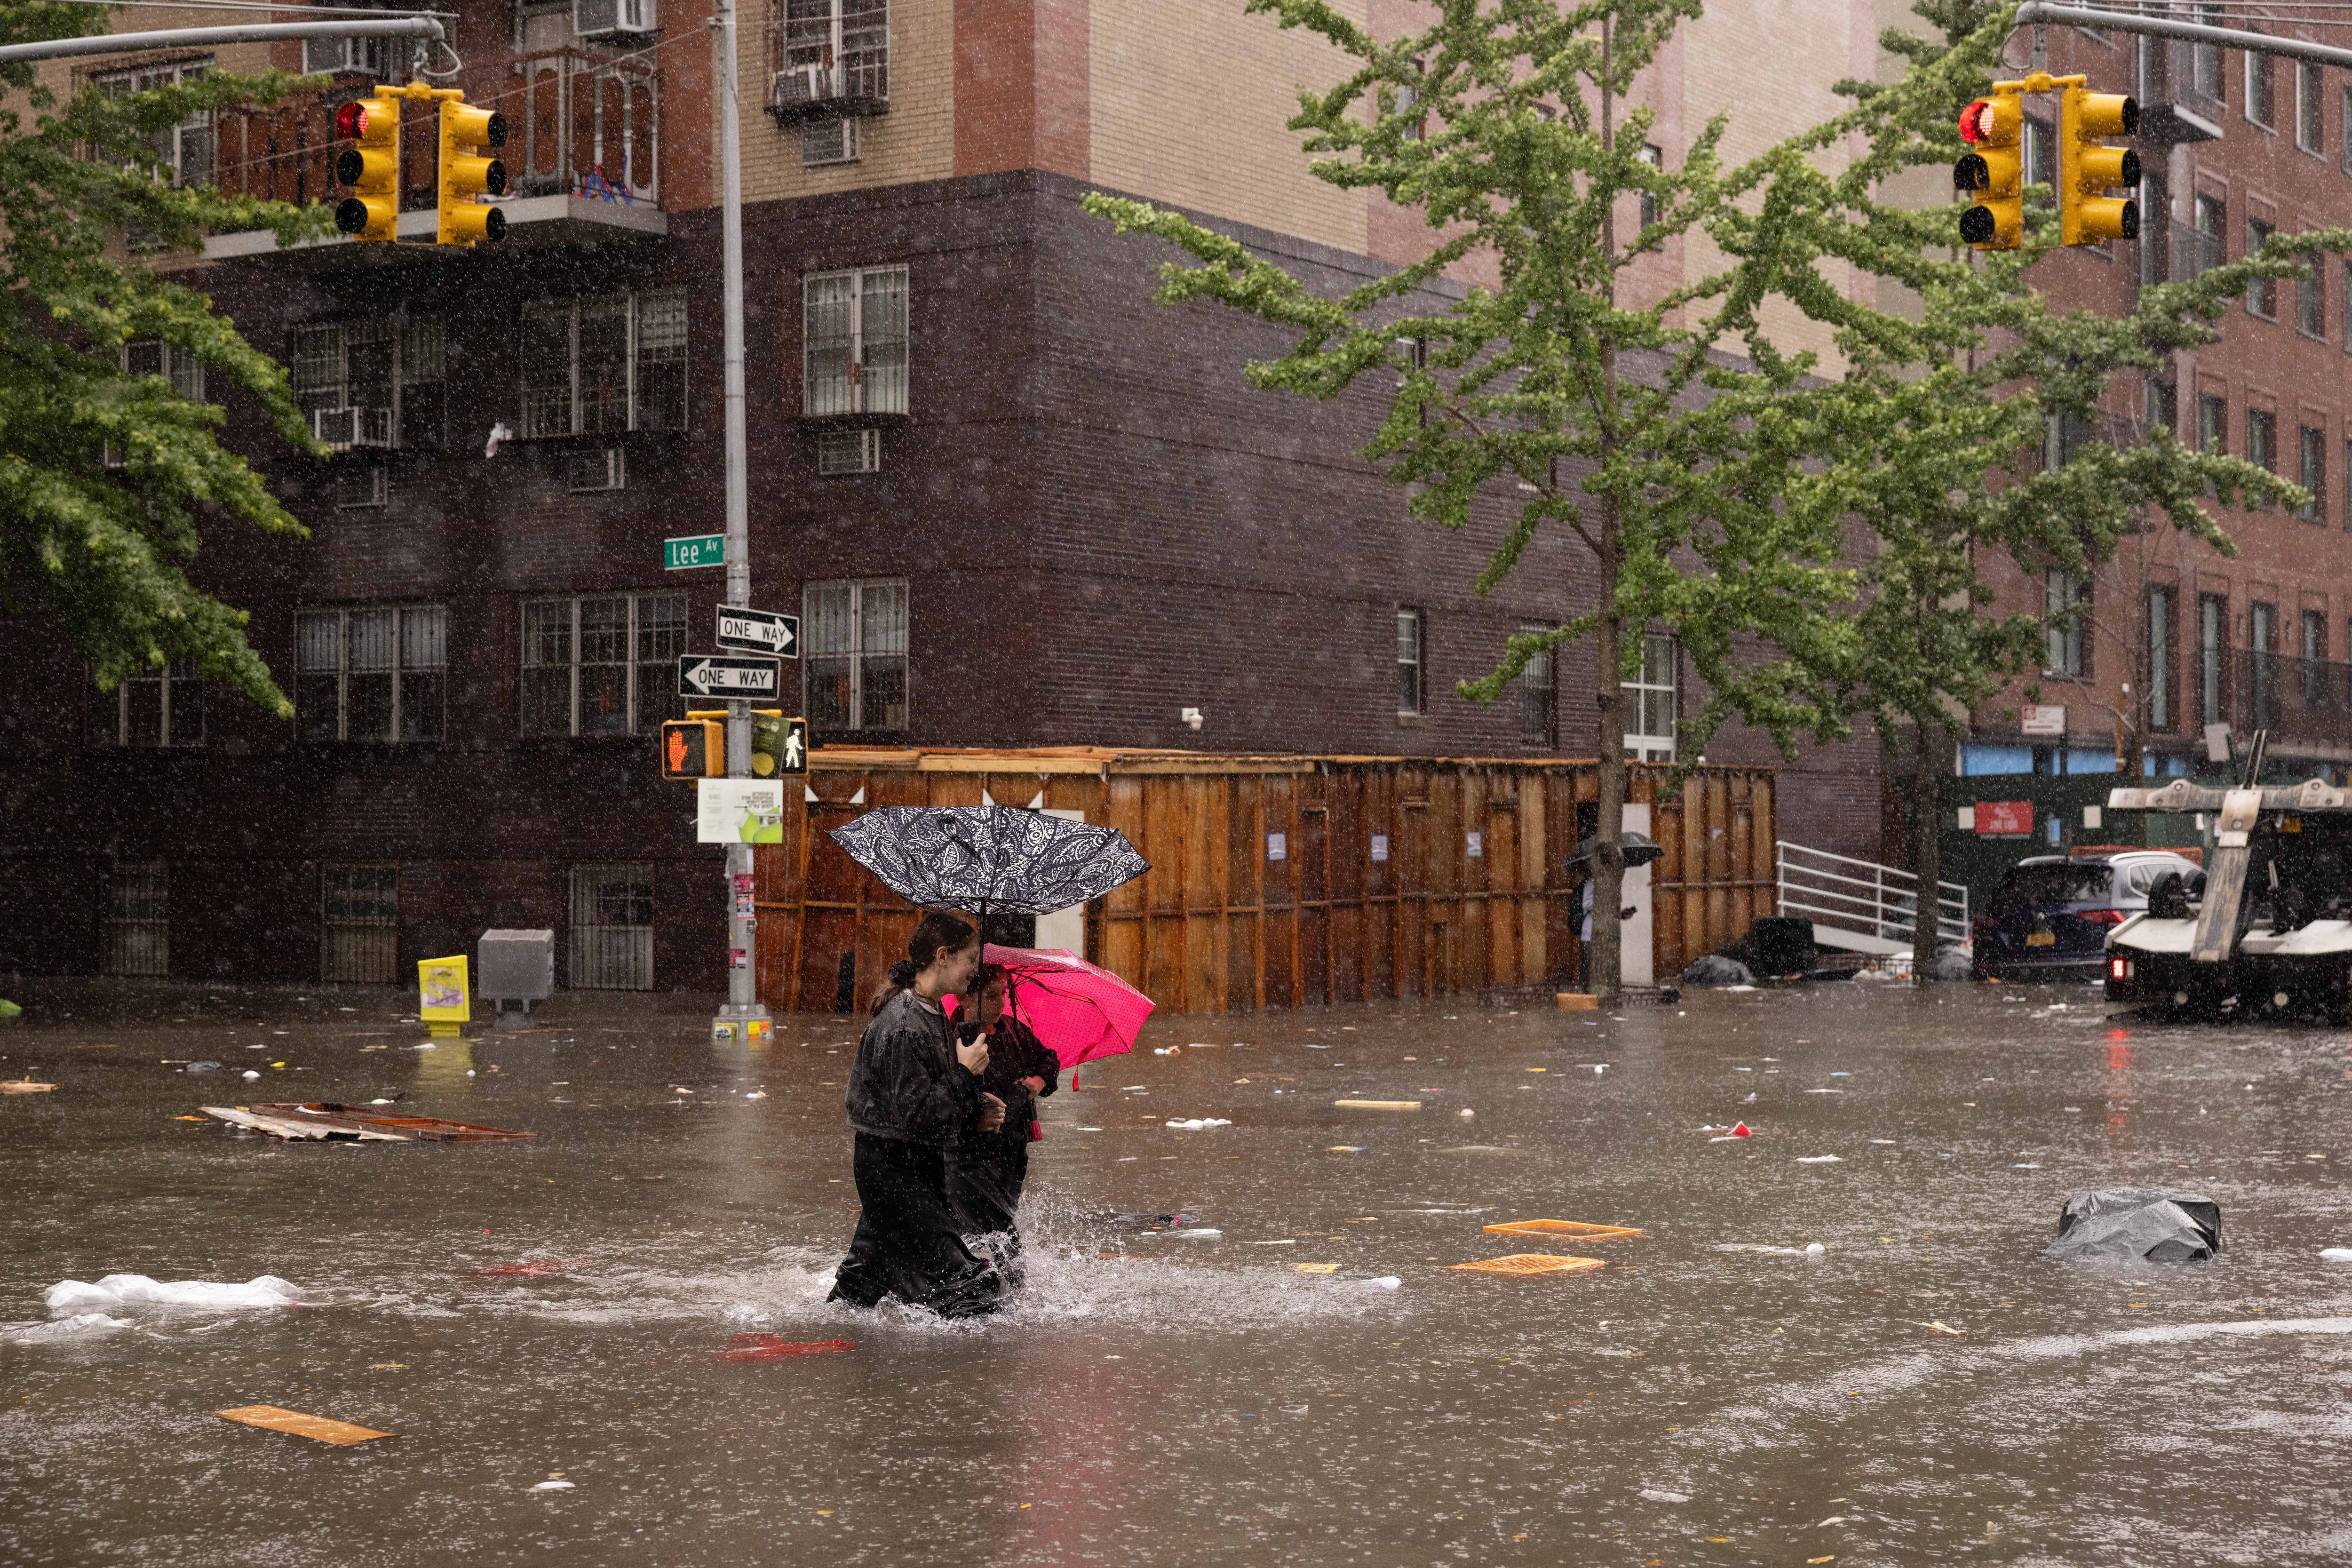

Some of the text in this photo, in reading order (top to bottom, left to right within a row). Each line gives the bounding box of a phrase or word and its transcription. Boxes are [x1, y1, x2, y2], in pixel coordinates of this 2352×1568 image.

[673, 540, 717, 565] Lee Av
[725, 621, 785, 642] ONE WAY
[699, 669, 768, 686] ONE WAY
